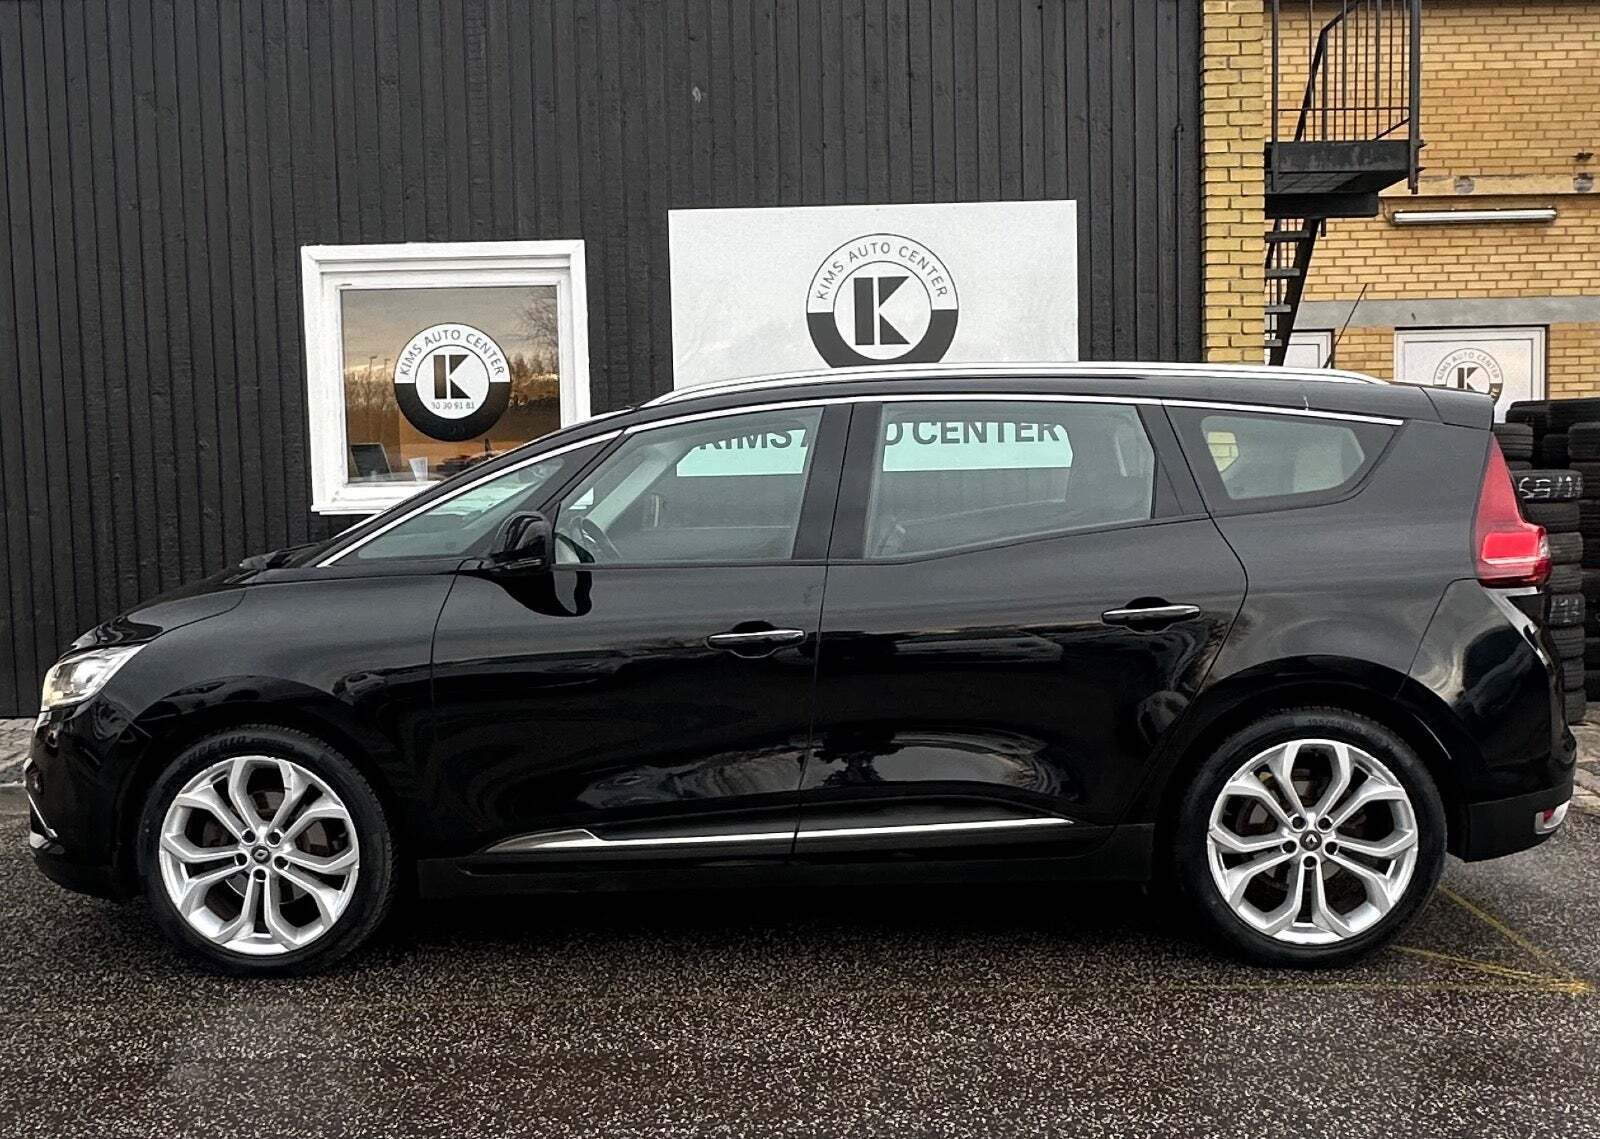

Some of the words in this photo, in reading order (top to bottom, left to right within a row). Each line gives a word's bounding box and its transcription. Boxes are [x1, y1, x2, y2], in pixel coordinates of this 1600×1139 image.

[816, 261, 844, 300] KIMS
[849, 242, 891, 263] AUTO
[898, 245, 948, 297] CENTER
[853, 276, 910, 345] K
[399, 343, 422, 376] KIMS
[424, 329, 461, 347] AUTO
[466, 333, 505, 376] CENTER
[433, 354, 471, 399] K
[913, 421, 1060, 444] CENTER
